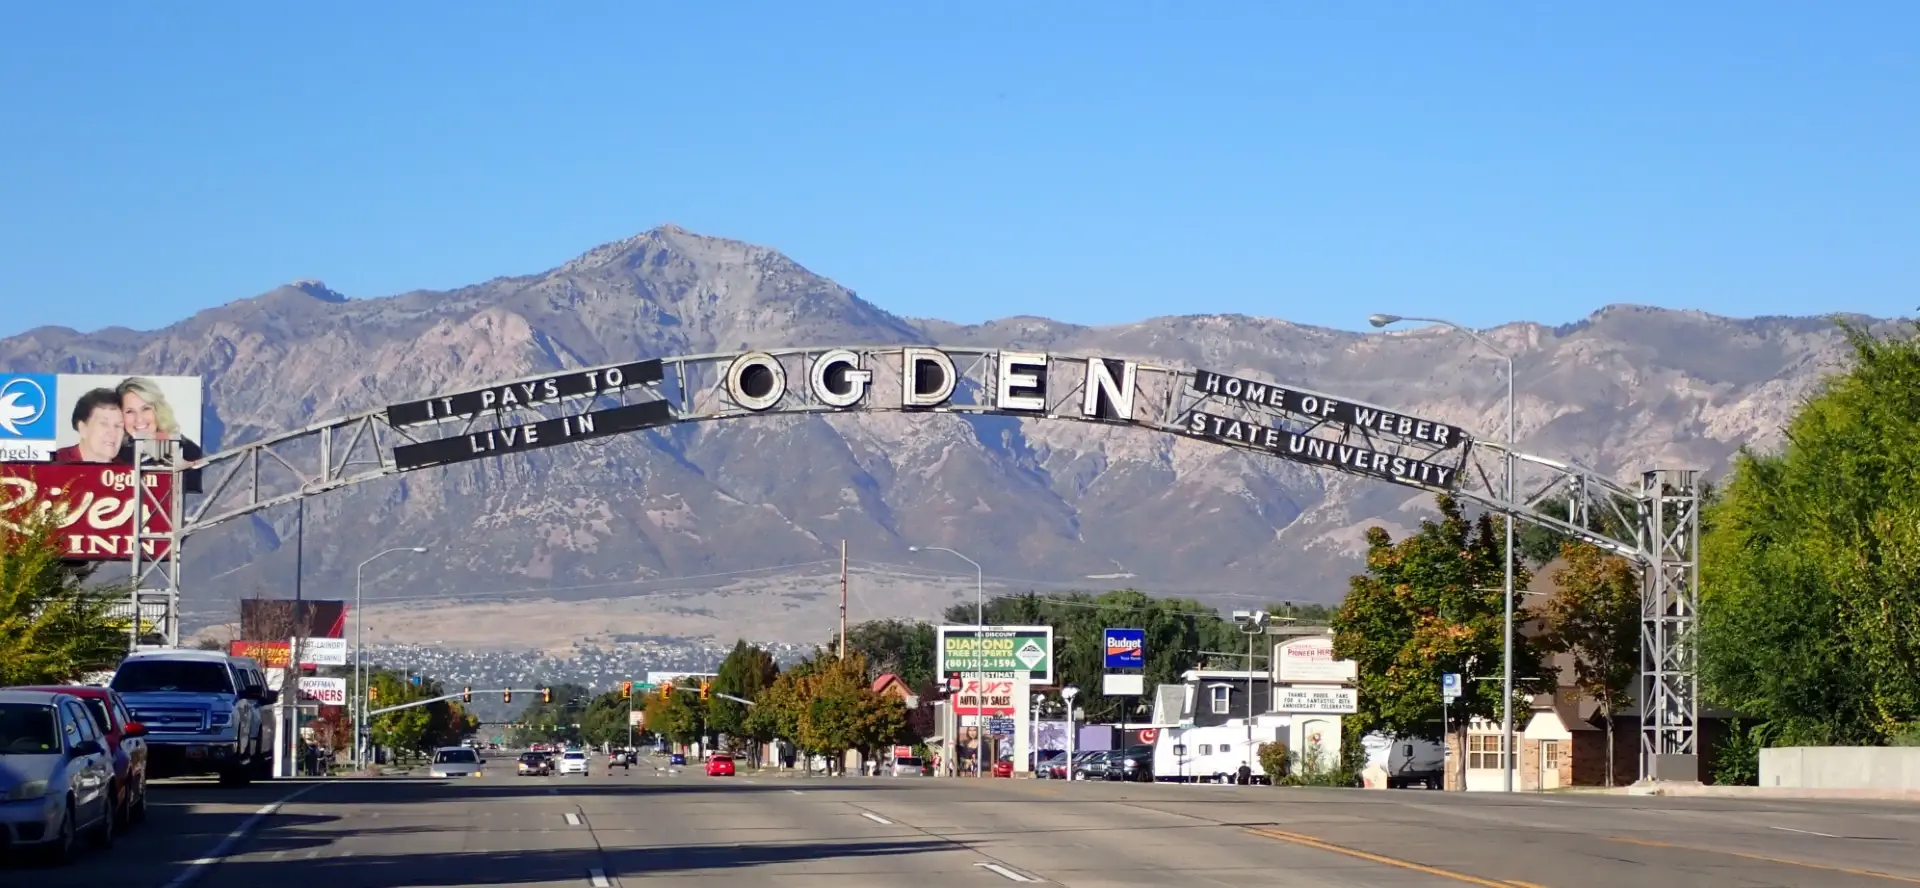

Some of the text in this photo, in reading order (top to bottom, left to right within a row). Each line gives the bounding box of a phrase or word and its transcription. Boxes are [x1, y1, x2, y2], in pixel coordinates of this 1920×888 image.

[427, 367, 624, 418] IT PAYS TO
[727, 347, 1138, 420] OGDEN
[1206, 373, 1450, 445] HOME OF WEBER
[470, 413, 595, 453] LIVE IN
[1190, 413, 1450, 486] STATE UNIVERSITY
[68, 535, 155, 554] INN
[946, 639, 1014, 650] DIAMOND
[1107, 637, 1142, 650] Budget
[1288, 648, 1315, 657] PIONEER
[991, 696, 1010, 705] SALES
